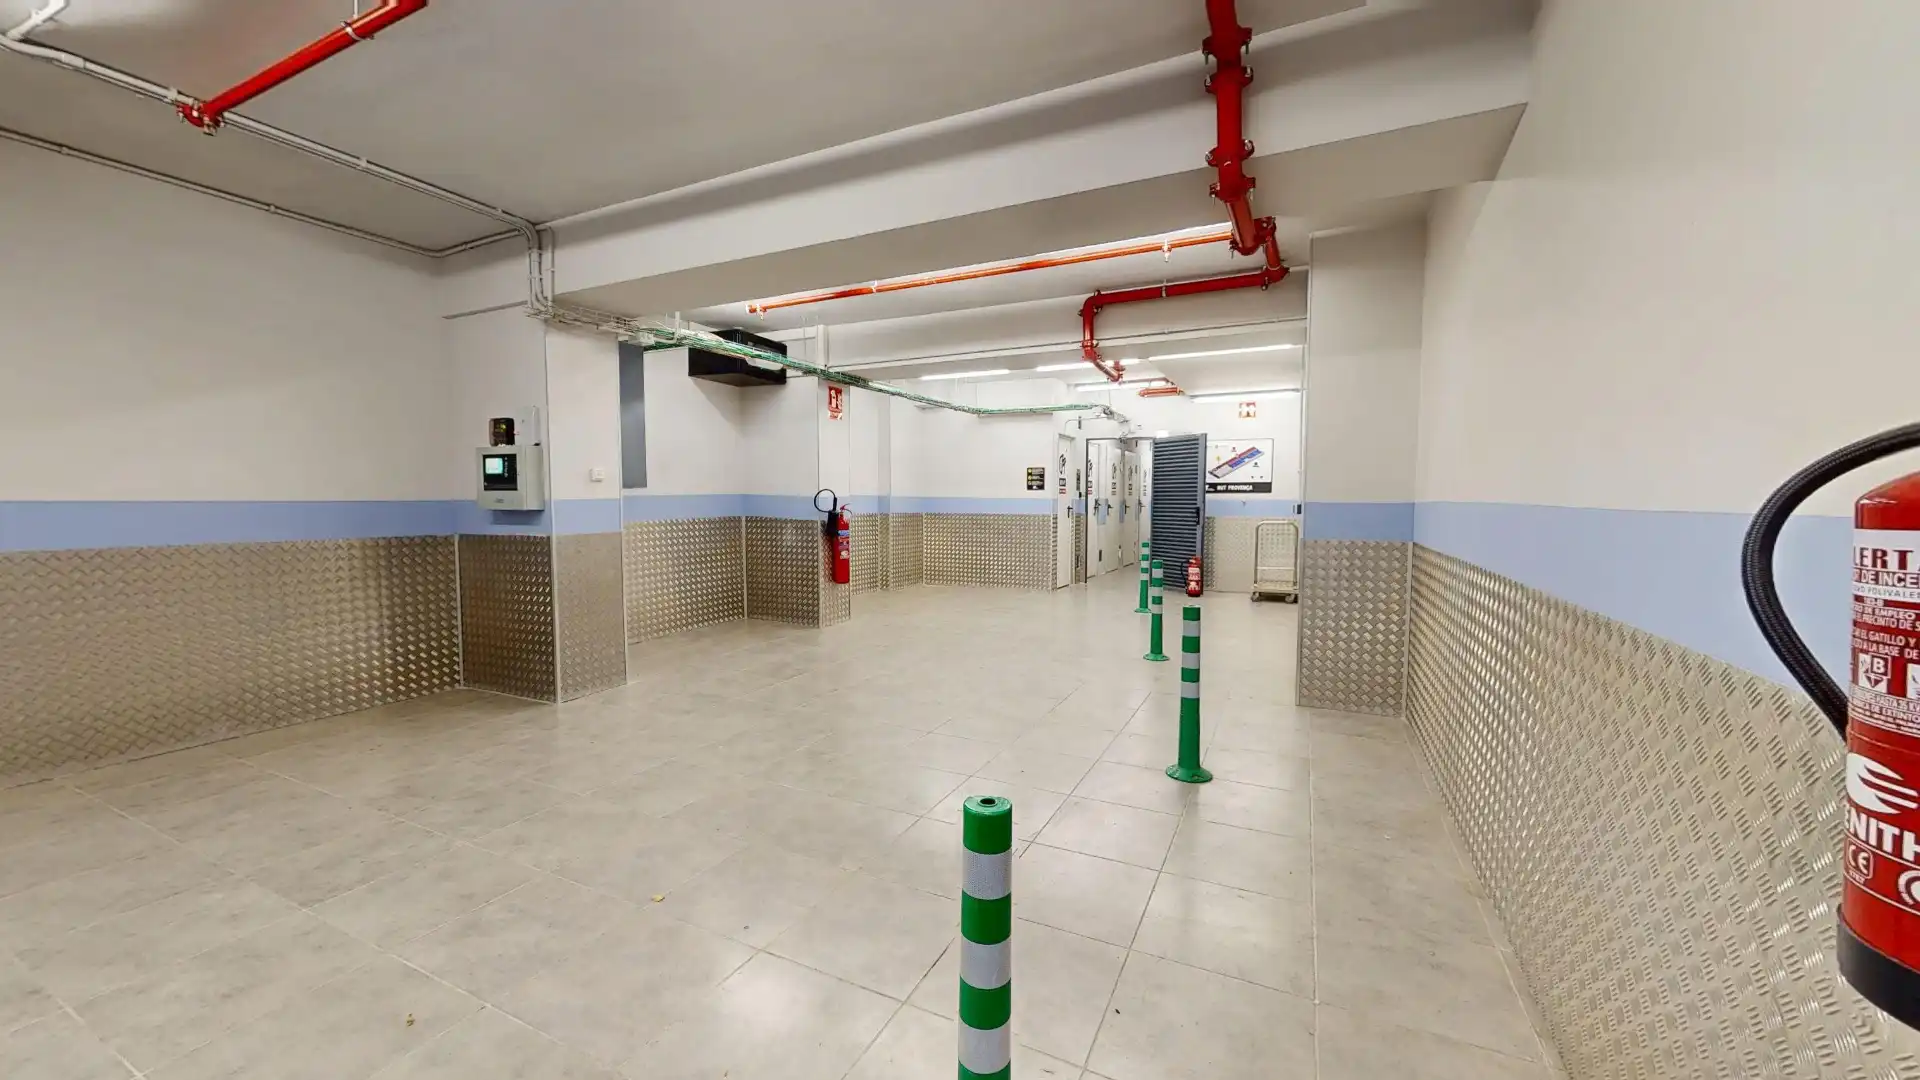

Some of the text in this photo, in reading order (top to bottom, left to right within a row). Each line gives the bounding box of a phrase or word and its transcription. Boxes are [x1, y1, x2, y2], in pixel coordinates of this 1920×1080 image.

[1853, 546, 1920, 571] LERT
[1861, 569, 1877, 584] DE
[1879, 571, 1920, 589] INCE
[1875, 608, 1916, 621] EMPLEO
[1899, 619, 1914, 631] DE
[1869, 631, 1906, 647] GATILLO
[1908, 636, 1917, 648] Y
[1879, 644, 1901, 657] BASE
[1904, 648, 1920, 660] DE
[1873, 657, 1886, 674] B
